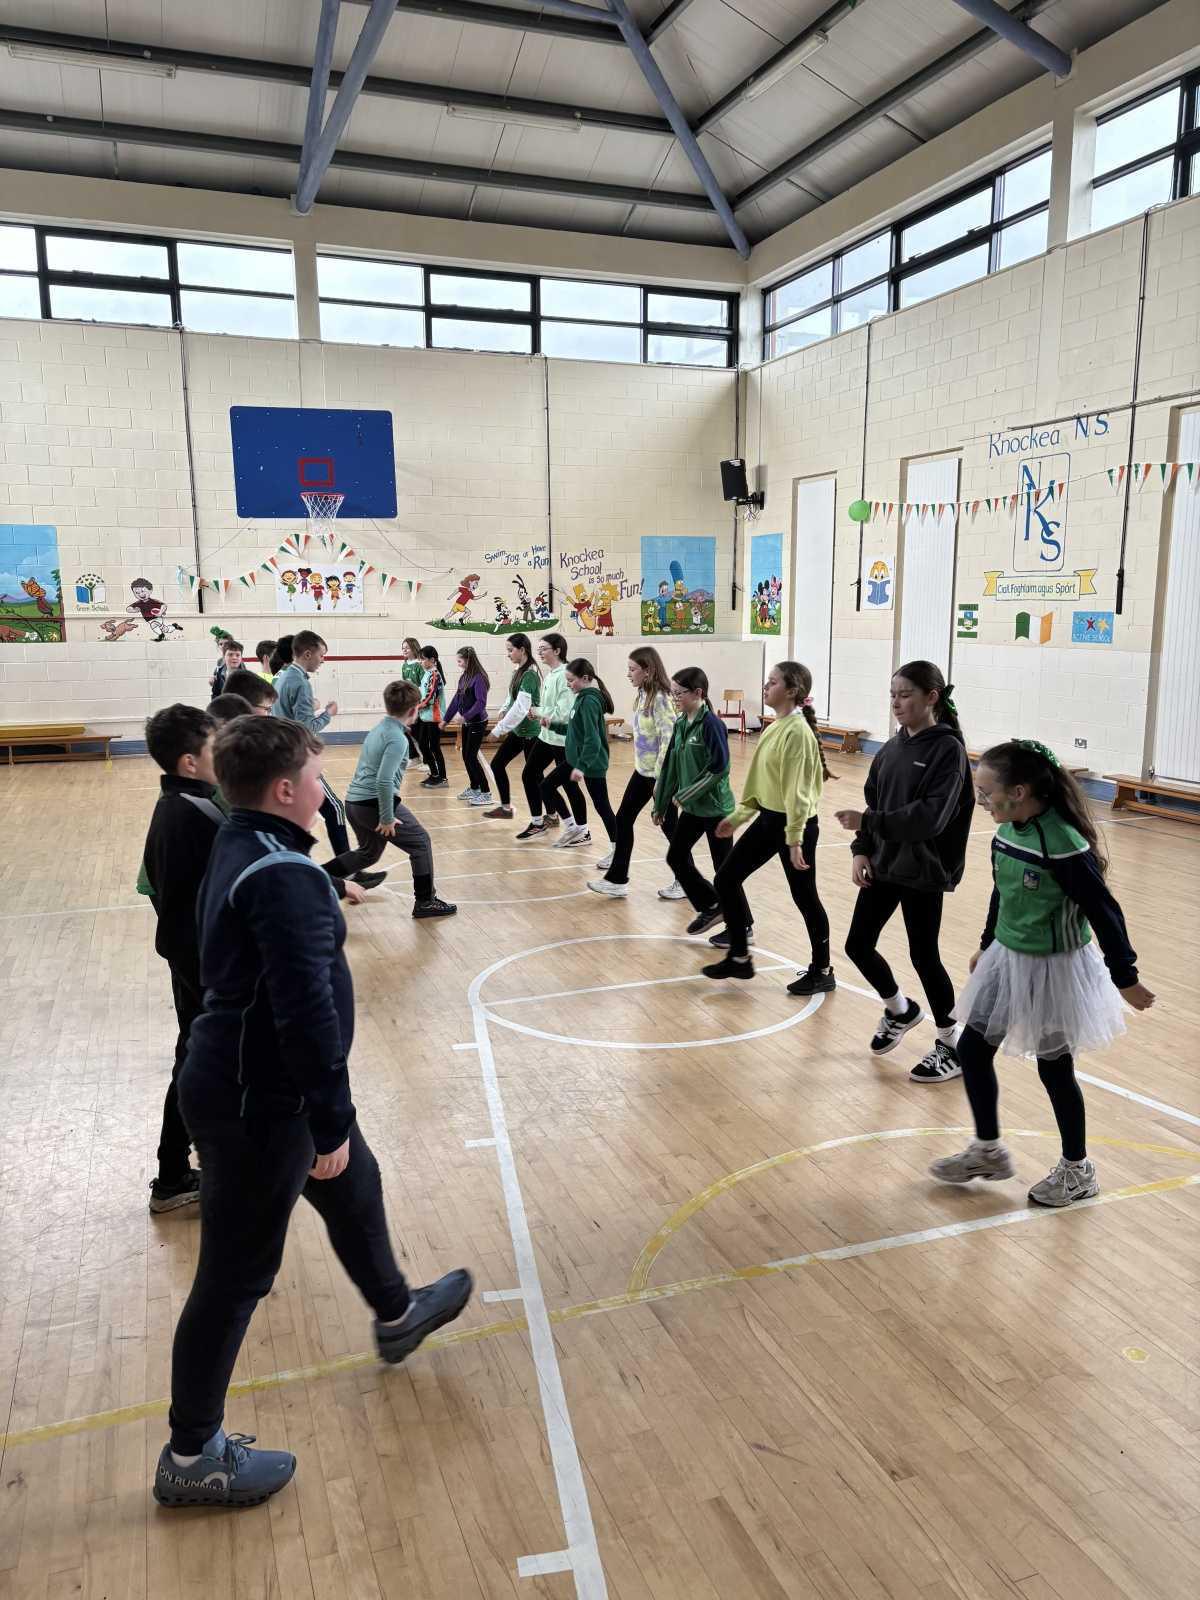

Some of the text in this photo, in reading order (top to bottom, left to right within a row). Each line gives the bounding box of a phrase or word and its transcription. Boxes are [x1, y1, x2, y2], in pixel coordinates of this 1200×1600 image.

[988, 427, 1061, 459] Knockea
[533, 556, 550, 569] Run
[559, 548, 605, 568] Knockea
[571, 562, 602, 580] School
[588, 576, 594, 584] is
[606, 568, 625, 582] much
[620, 578, 645, 600] Fun!
